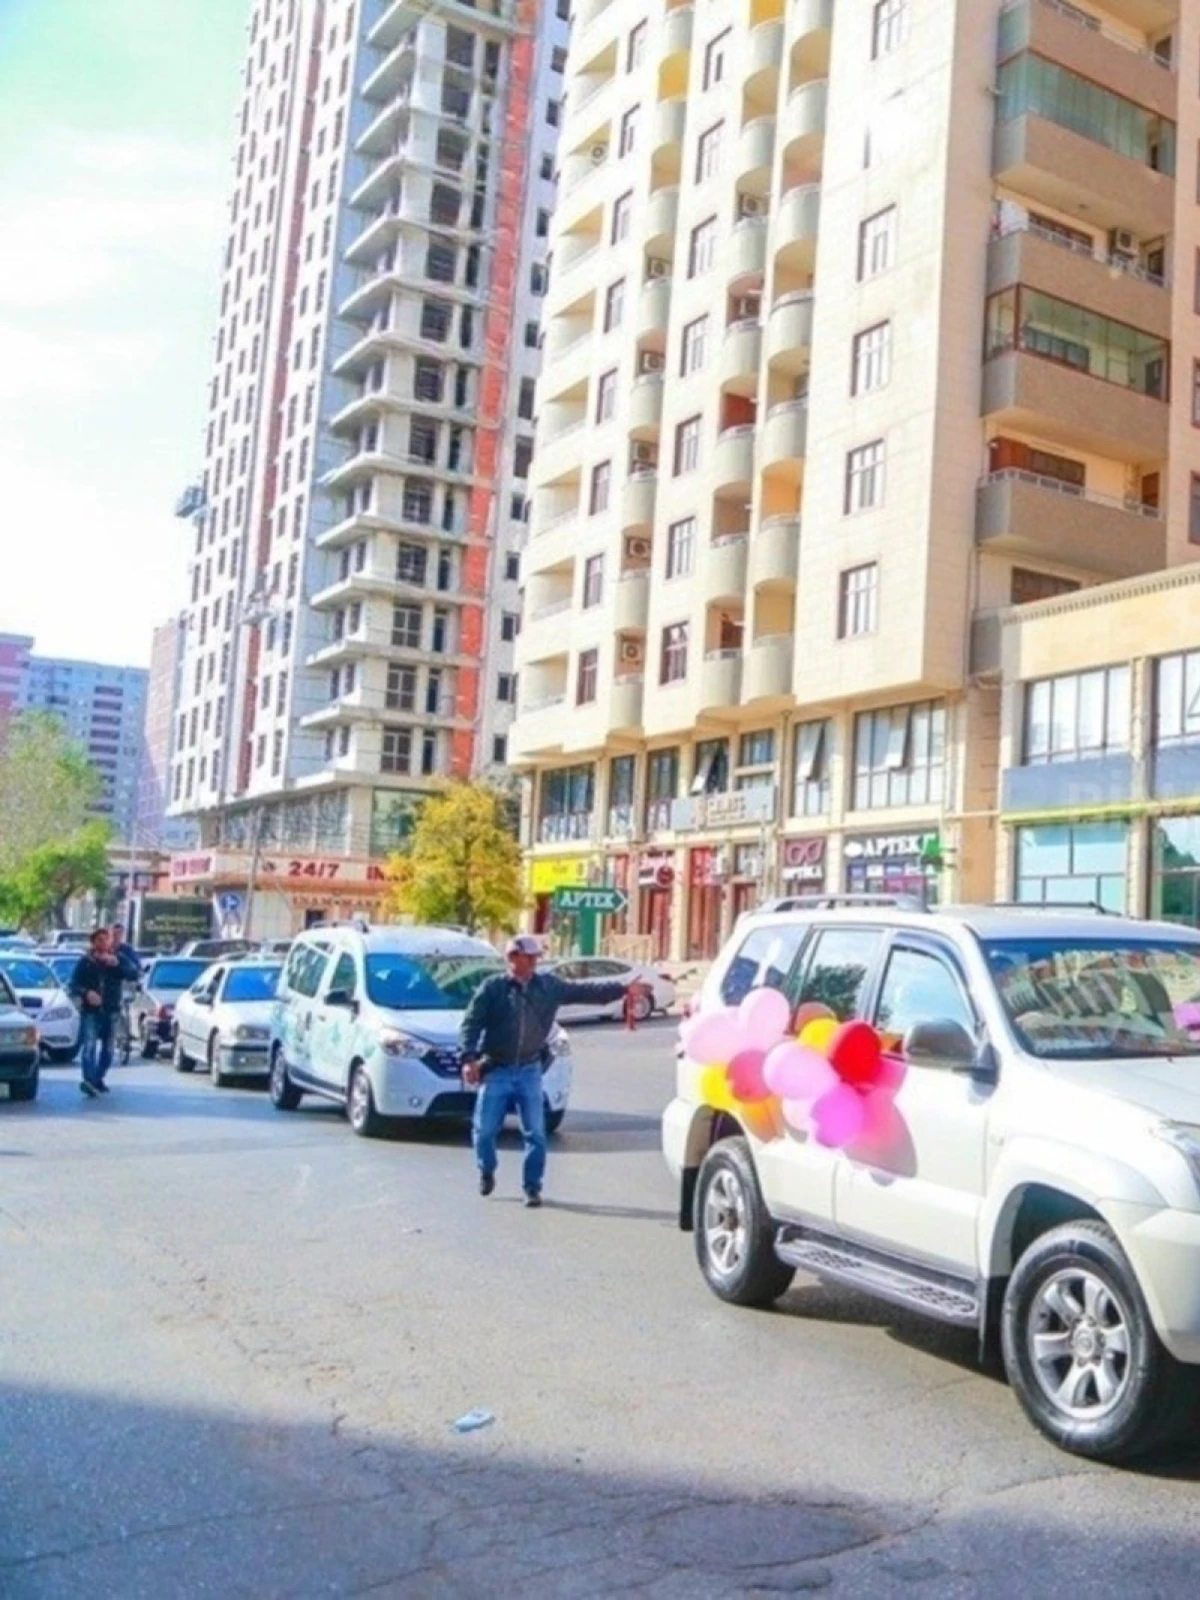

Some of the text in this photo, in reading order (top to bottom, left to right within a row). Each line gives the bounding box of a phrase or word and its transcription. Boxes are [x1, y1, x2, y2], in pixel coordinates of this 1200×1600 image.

[863, 834, 922, 857] APTEK
[288, 860, 340, 879] 24/7
[559, 890, 615, 908] APTEK
